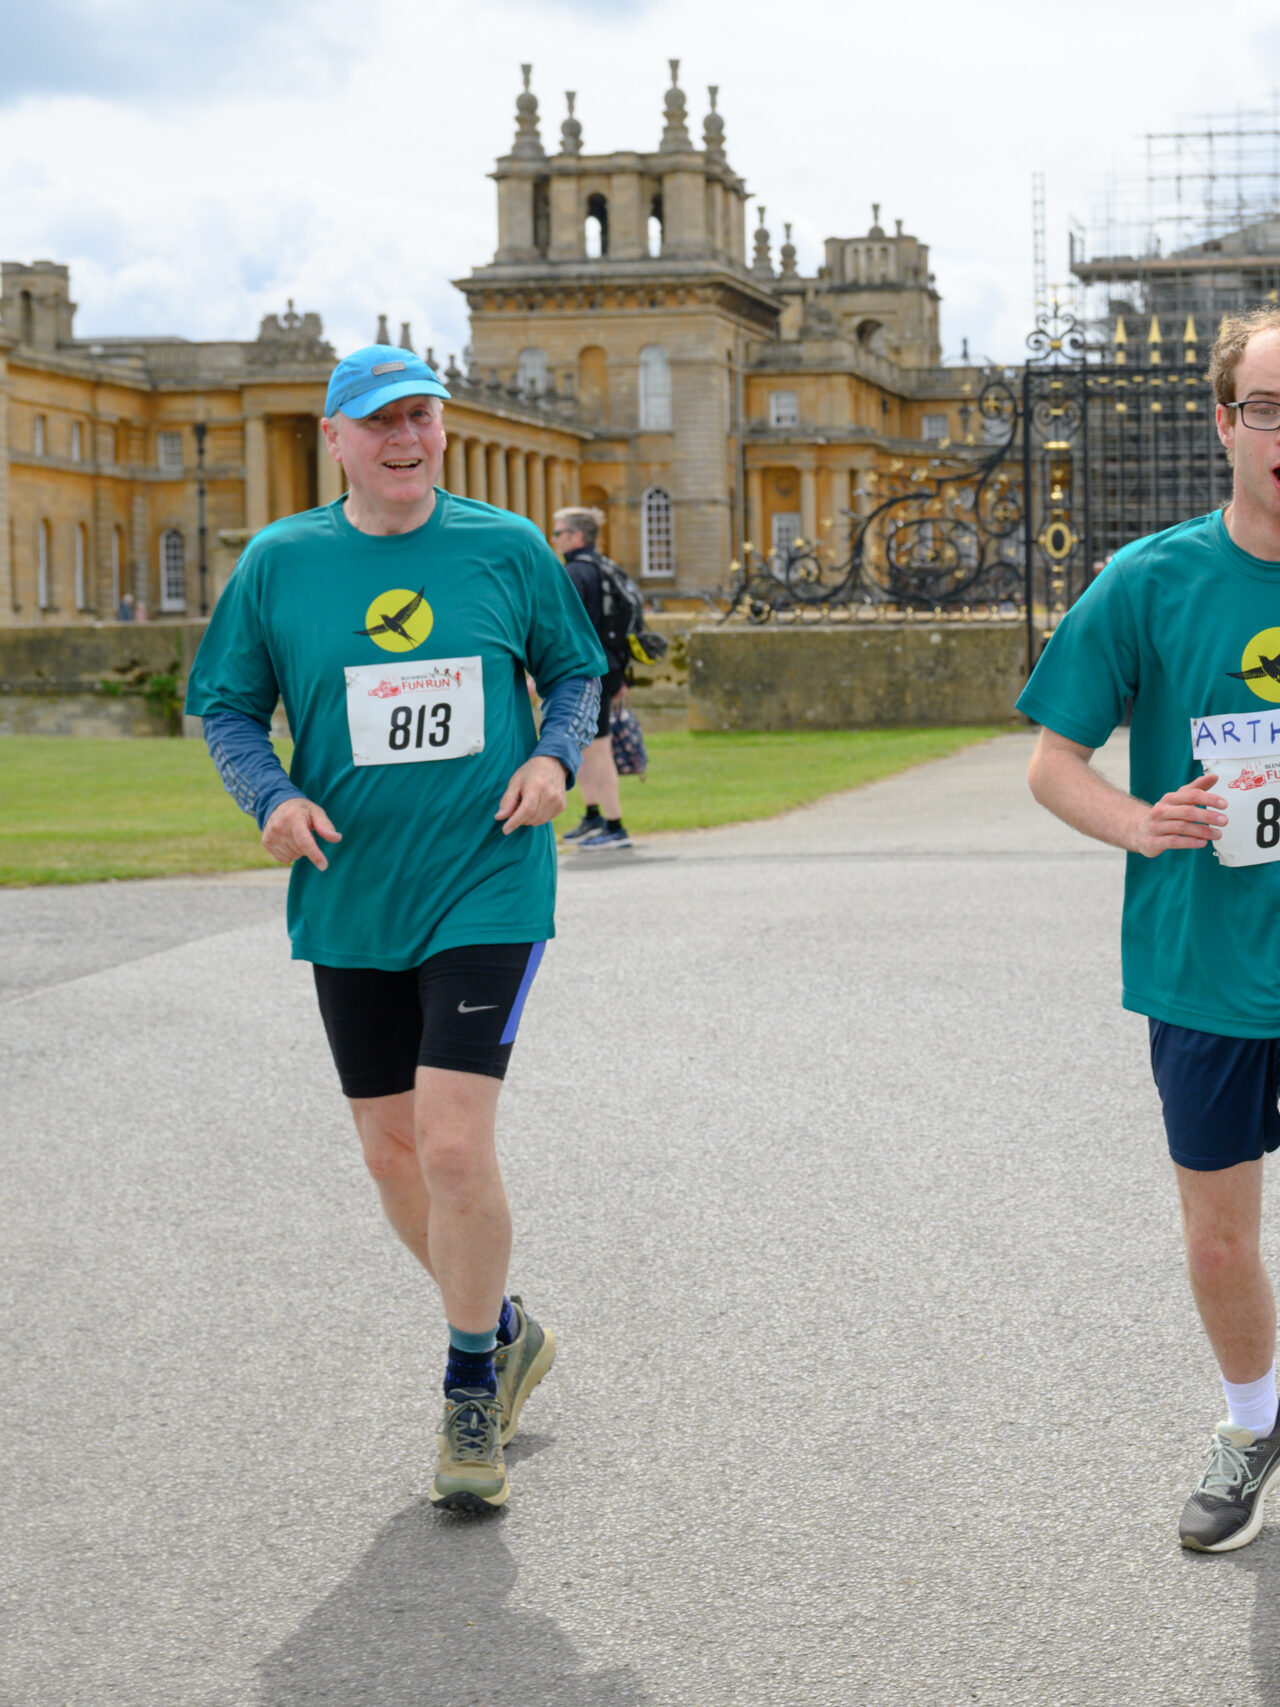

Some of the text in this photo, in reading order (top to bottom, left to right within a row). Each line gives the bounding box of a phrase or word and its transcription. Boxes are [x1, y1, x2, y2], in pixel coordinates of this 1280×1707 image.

[401, 680, 424, 690] FUN
[425, 677, 450, 688] RUN
[388, 702, 452, 751] 813
